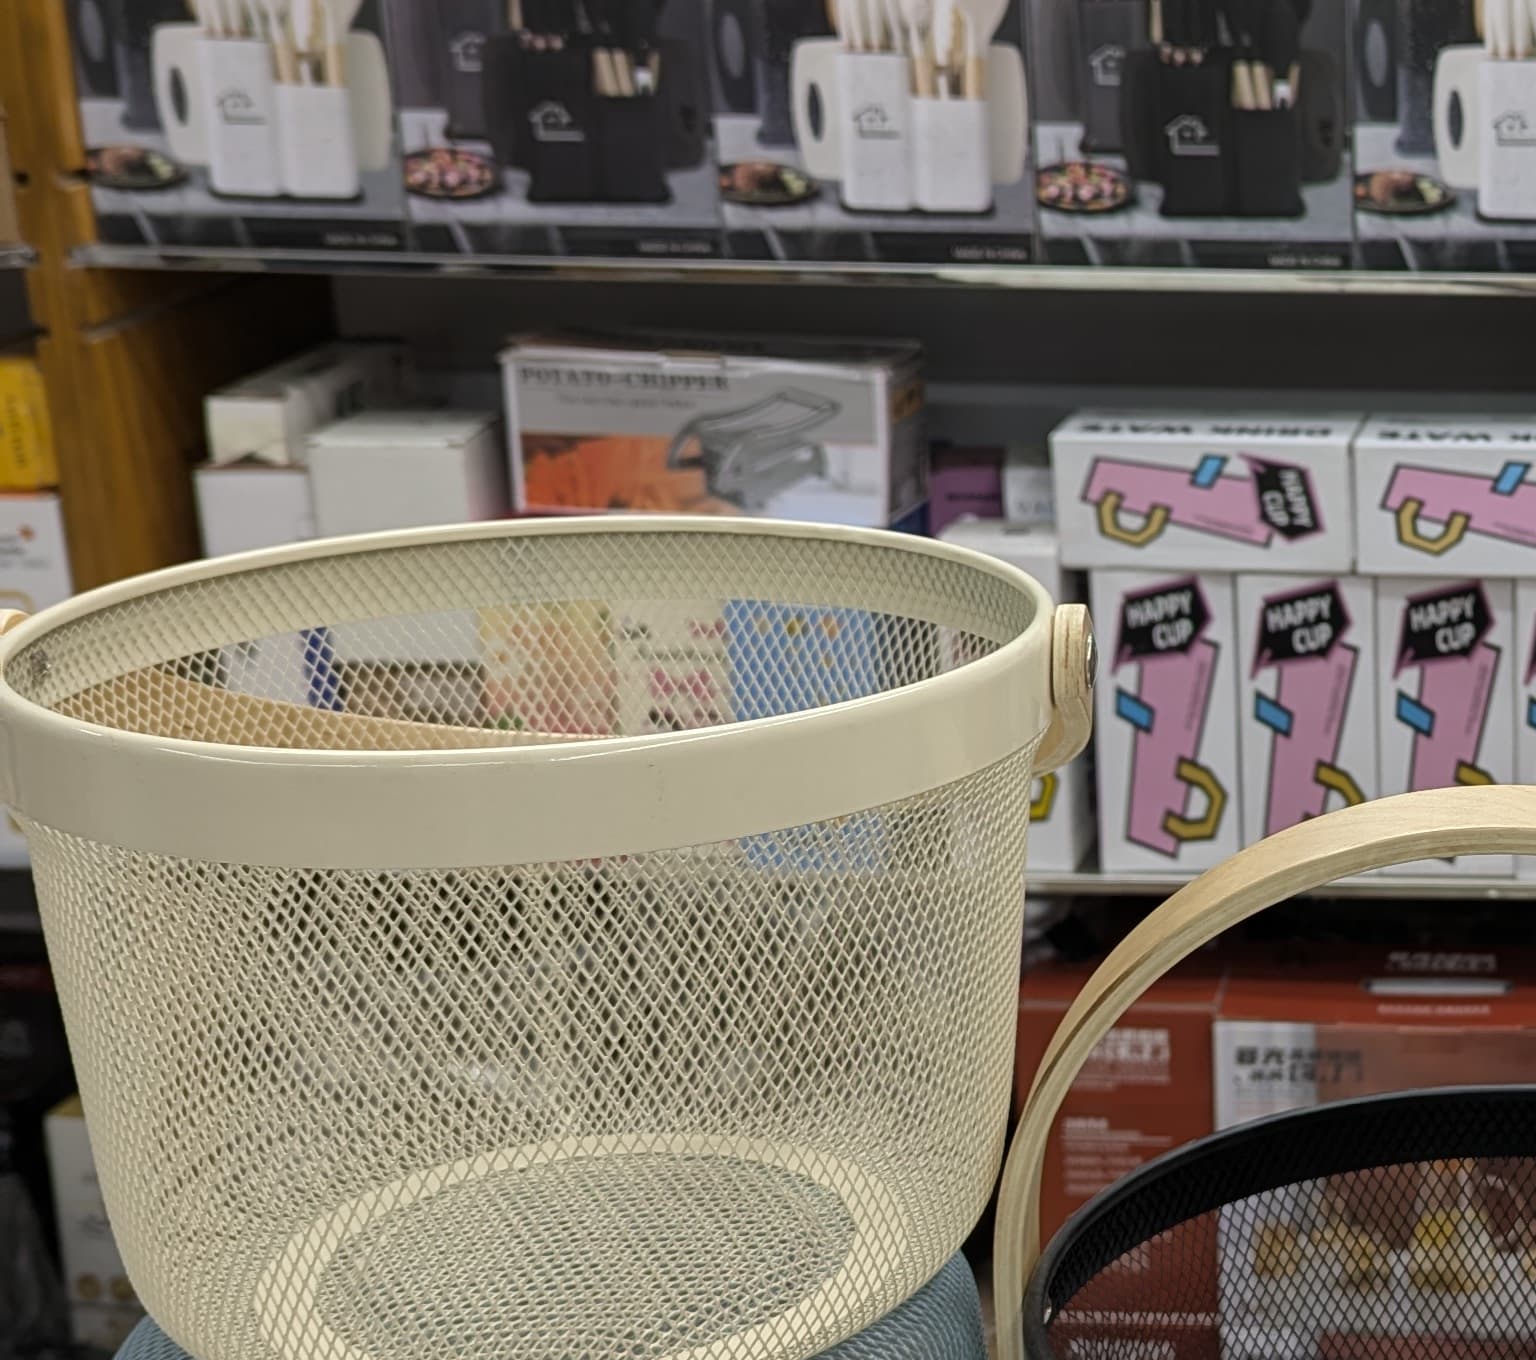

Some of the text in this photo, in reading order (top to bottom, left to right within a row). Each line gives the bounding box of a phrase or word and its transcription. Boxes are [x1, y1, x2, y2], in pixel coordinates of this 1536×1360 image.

[1261, 490, 1290, 530] CUP
[1280, 468, 1312, 529] HAPPY
[1126, 591, 1194, 627] HAPPY
[1266, 593, 1334, 630] HAPPY
[1409, 594, 1477, 631] HAPPY
[1151, 620, 1194, 650] CUP
[1292, 624, 1333, 653] CUP
[1434, 622, 1477, 653] CUP
